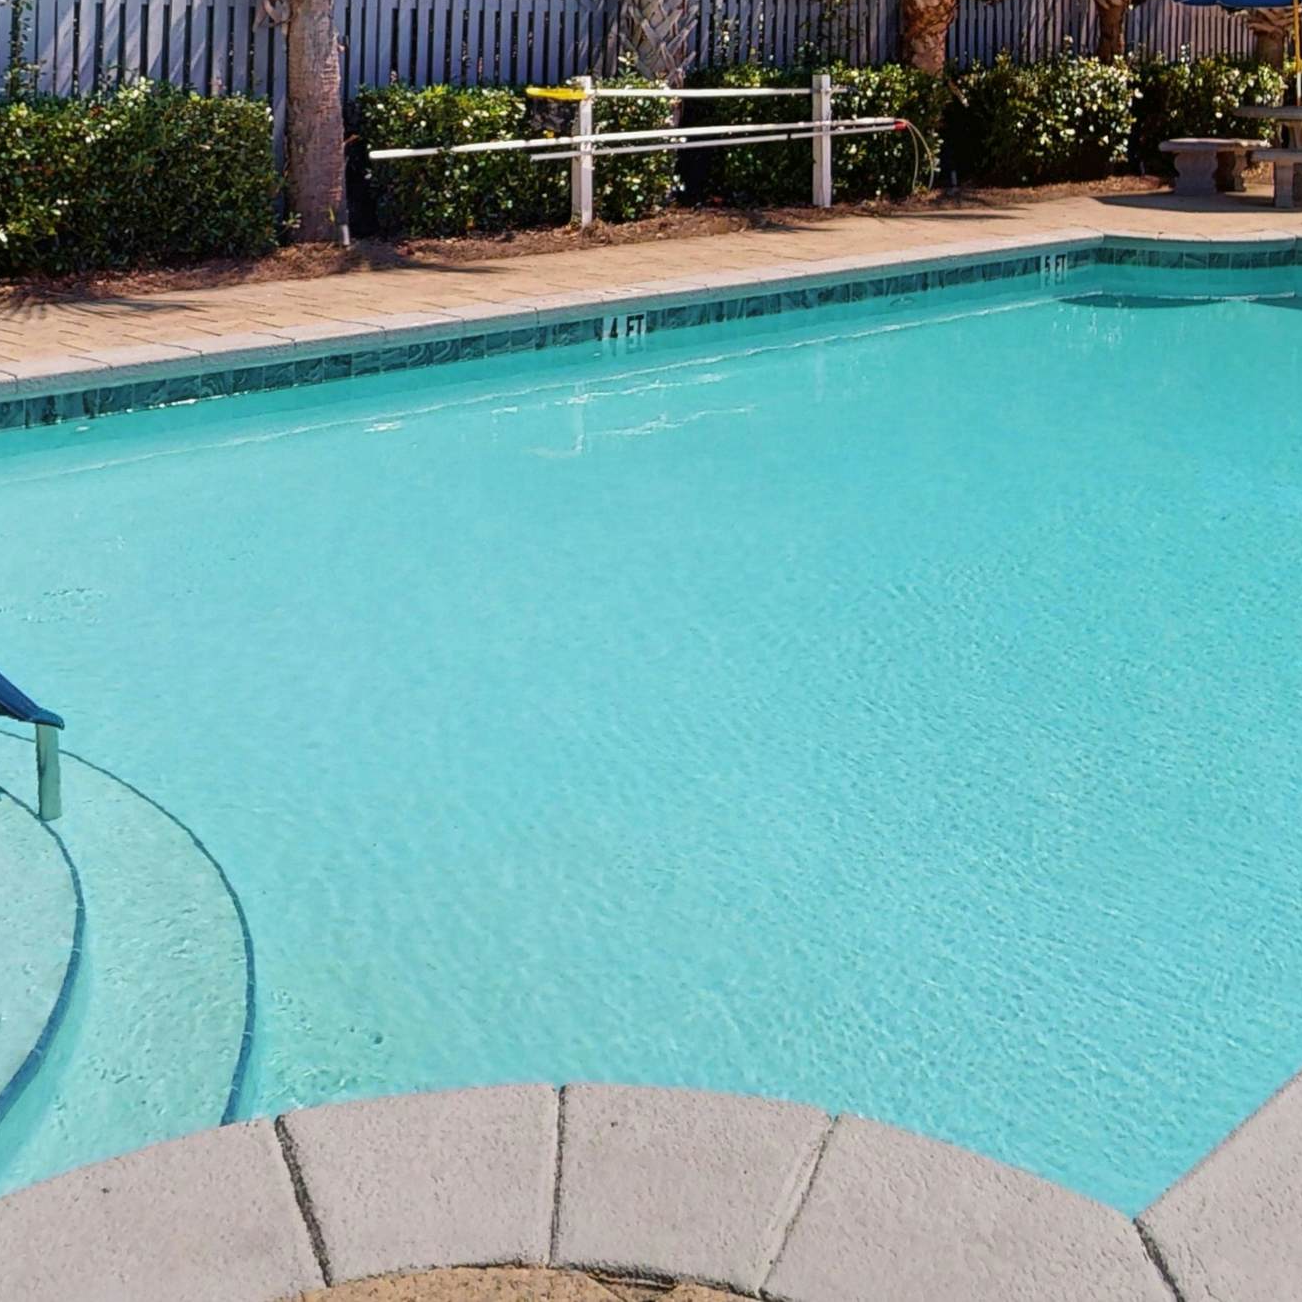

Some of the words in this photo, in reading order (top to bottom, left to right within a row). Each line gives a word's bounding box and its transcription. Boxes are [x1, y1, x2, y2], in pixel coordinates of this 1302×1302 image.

[1044, 255, 1051, 273] 5
[1055, 254, 1067, 273] FT
[609, 317, 618, 338] 4
[625, 314, 645, 336] FT
